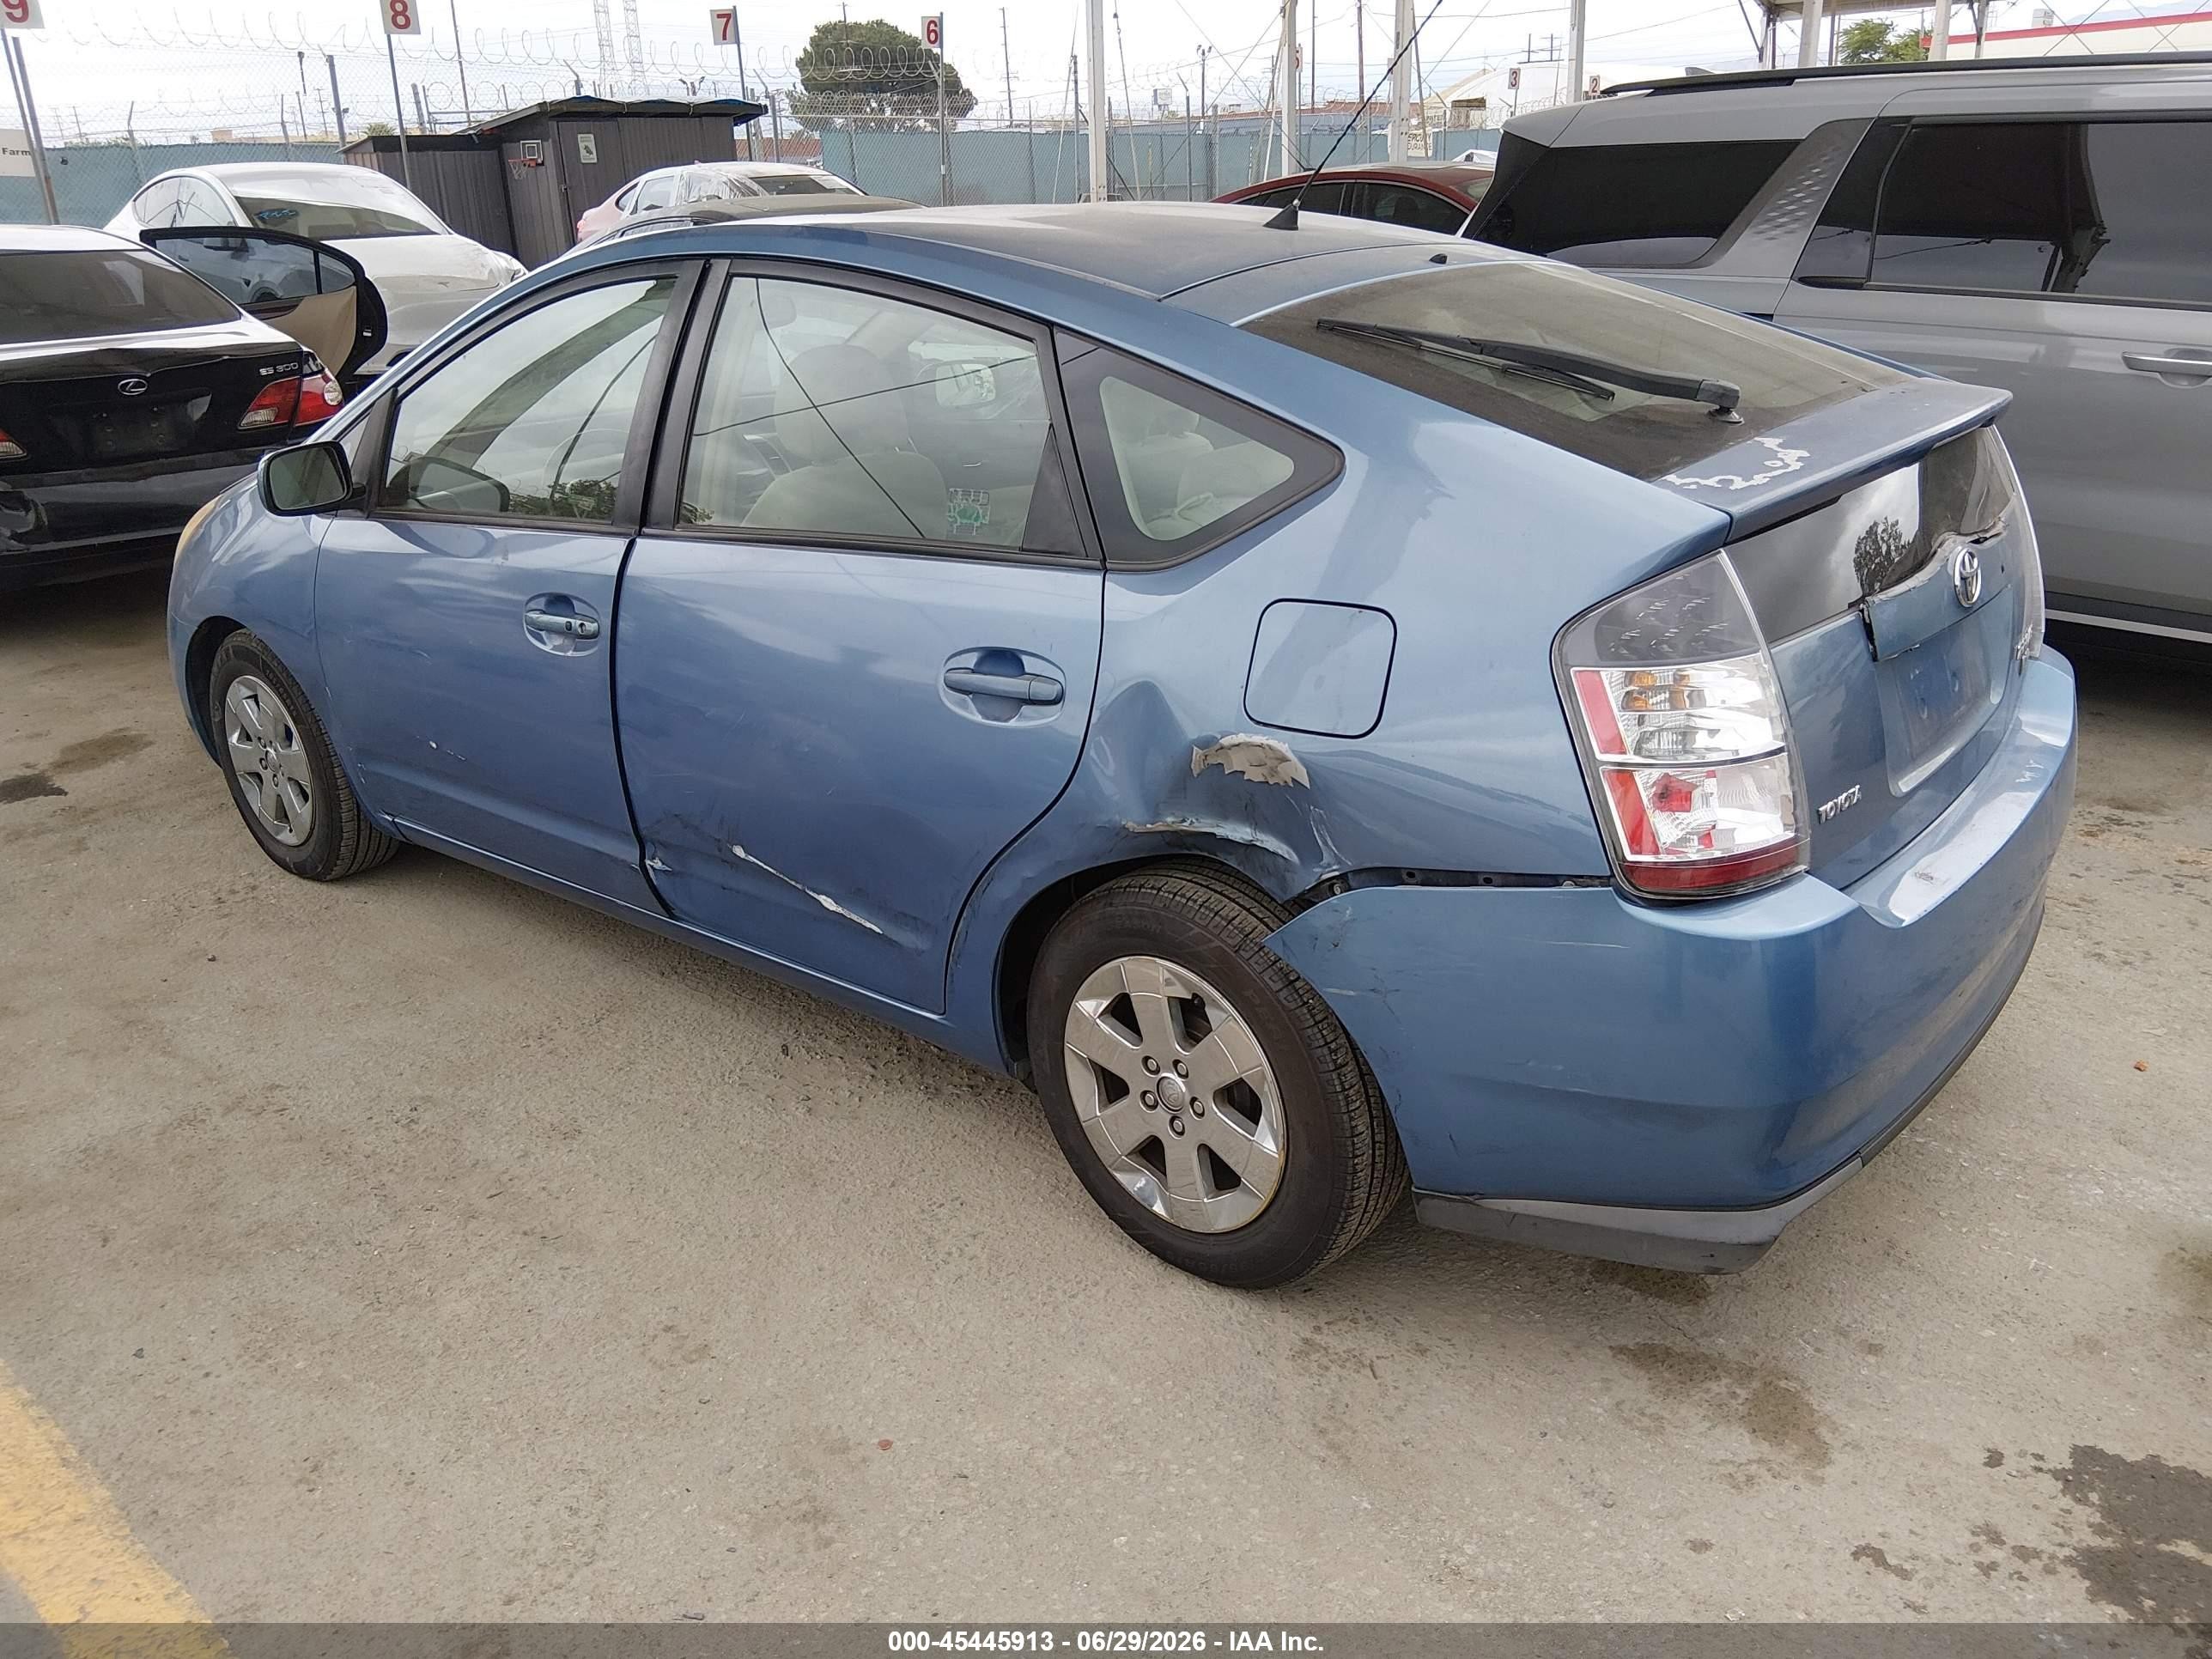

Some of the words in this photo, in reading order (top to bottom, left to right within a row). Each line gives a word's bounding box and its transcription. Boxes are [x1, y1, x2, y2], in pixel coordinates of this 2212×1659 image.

[2, 0, 29, 23] 9
[390, 0, 411, 30] 8
[716, 13, 732, 41] 7
[927, 20, 939, 45] 6
[1510, 70, 1518, 88] 3
[1591, 77, 1599, 94] 2
[2, 147, 31, 156] Farm
[259, 367, 275, 376] ES
[276, 362, 299, 373] 300
[1818, 785, 1862, 824] TOYOTA
